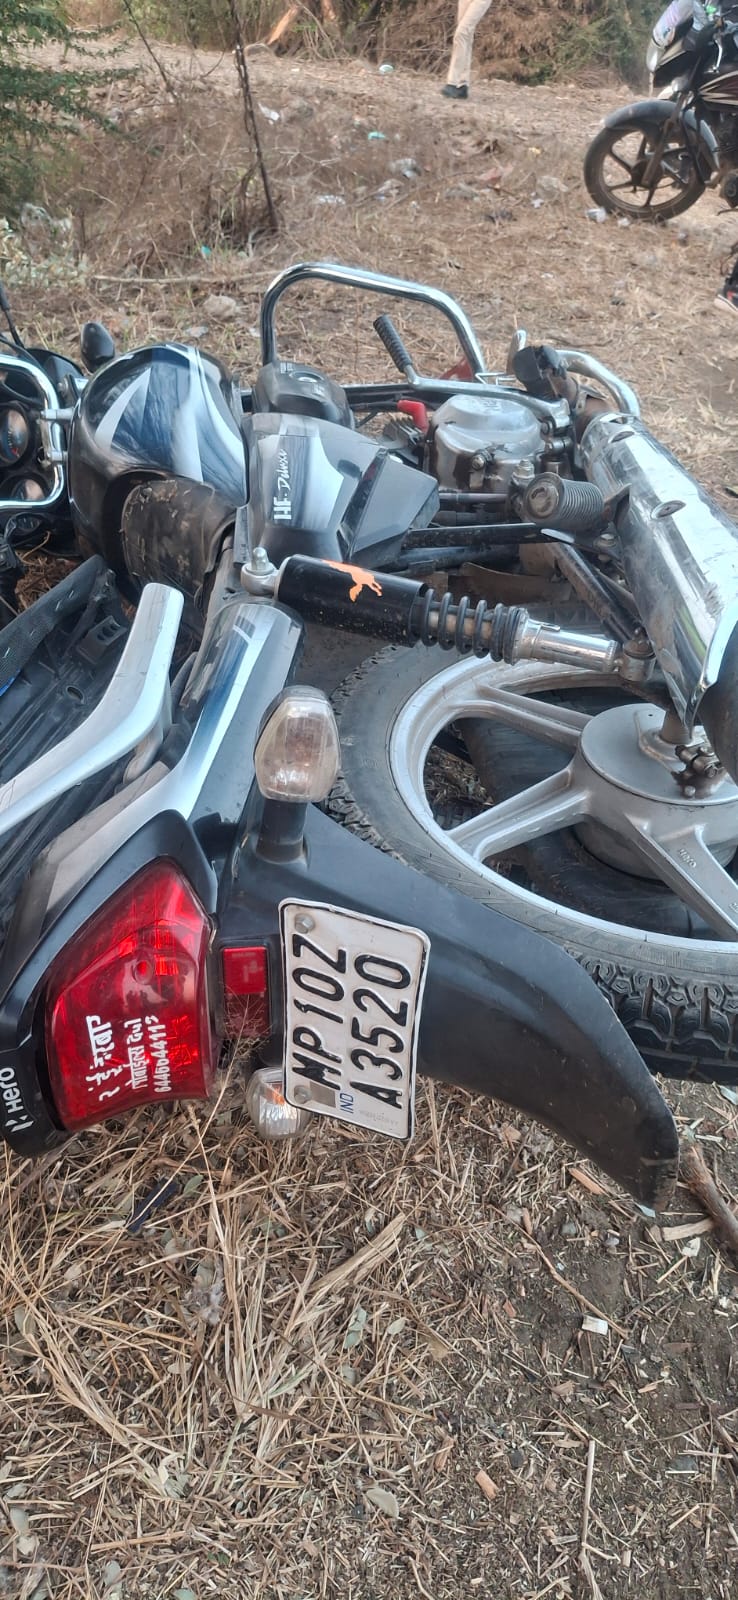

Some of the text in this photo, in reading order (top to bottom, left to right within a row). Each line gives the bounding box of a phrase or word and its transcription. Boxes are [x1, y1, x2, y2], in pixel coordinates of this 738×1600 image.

[275, 448, 292, 492] Deluxe
[349, 954, 411, 1110] A3520
[0, 1067, 24, 1113] Hero
[339, 1092, 355, 1115] IND
